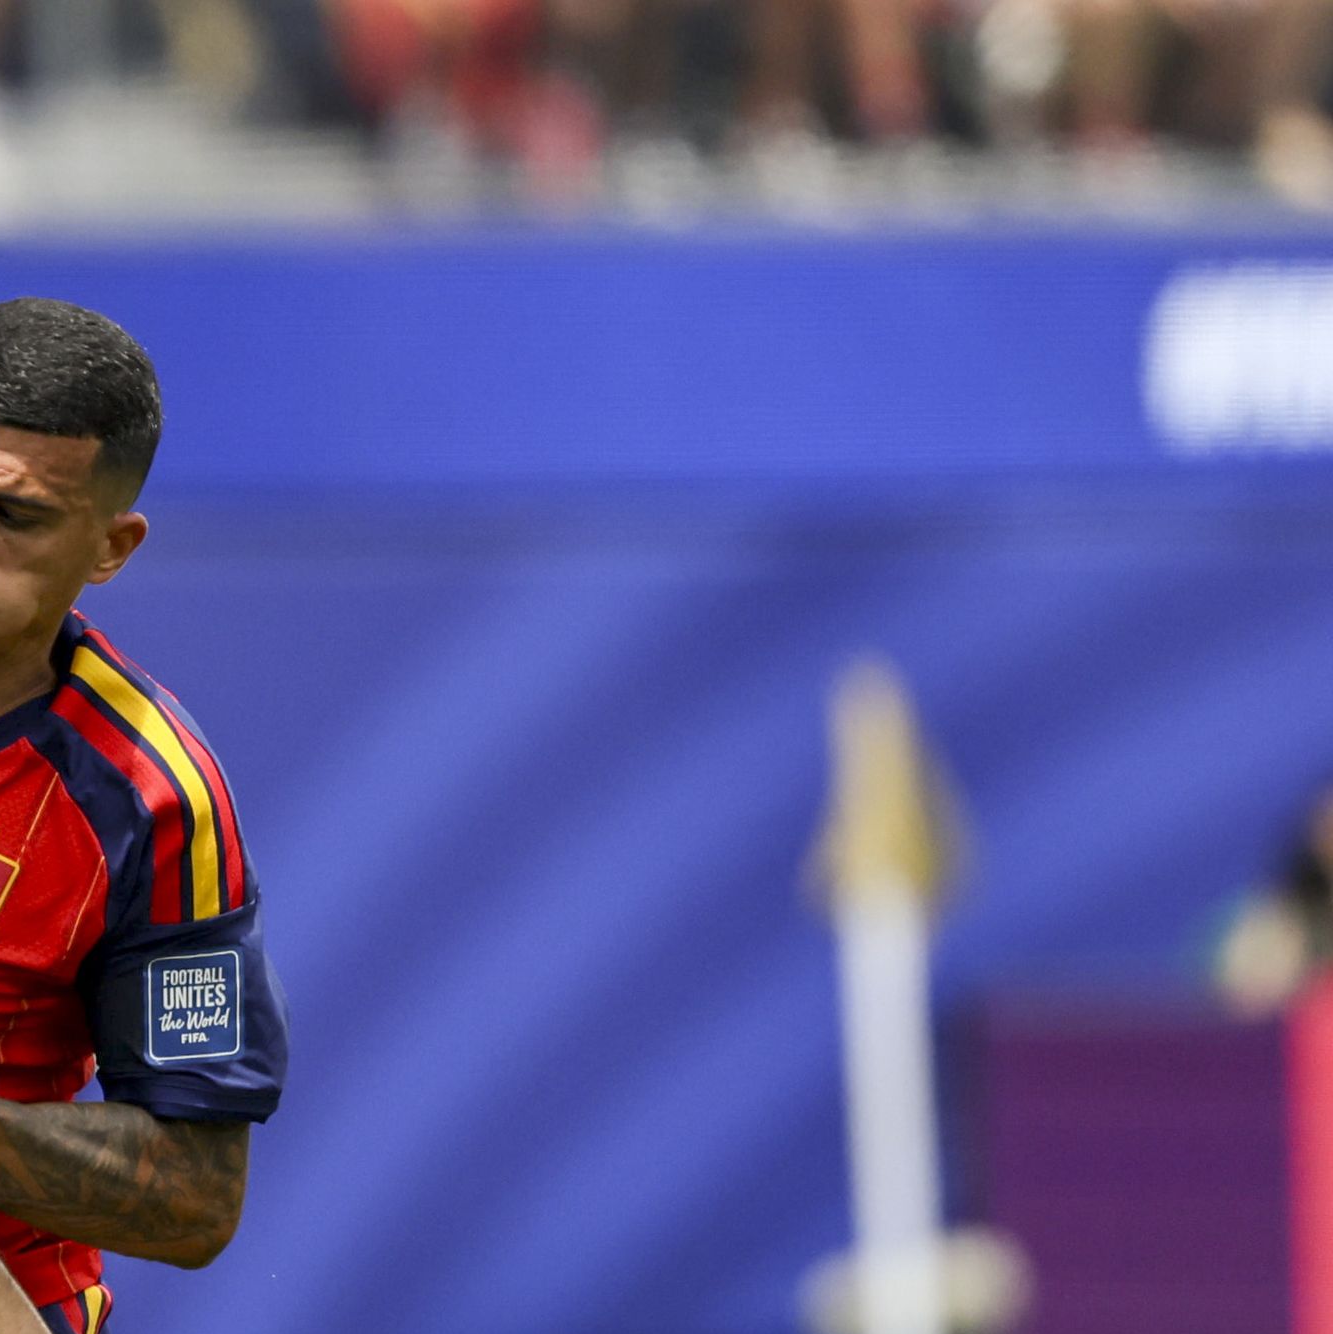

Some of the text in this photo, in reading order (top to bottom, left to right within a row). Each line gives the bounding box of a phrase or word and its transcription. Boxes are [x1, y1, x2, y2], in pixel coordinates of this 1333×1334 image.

[162, 966, 226, 986] FOOTBALL
[163, 983, 226, 1010] UNITES
[158, 1006, 230, 1032] the World
[181, 1032, 208, 1044] FIFA
